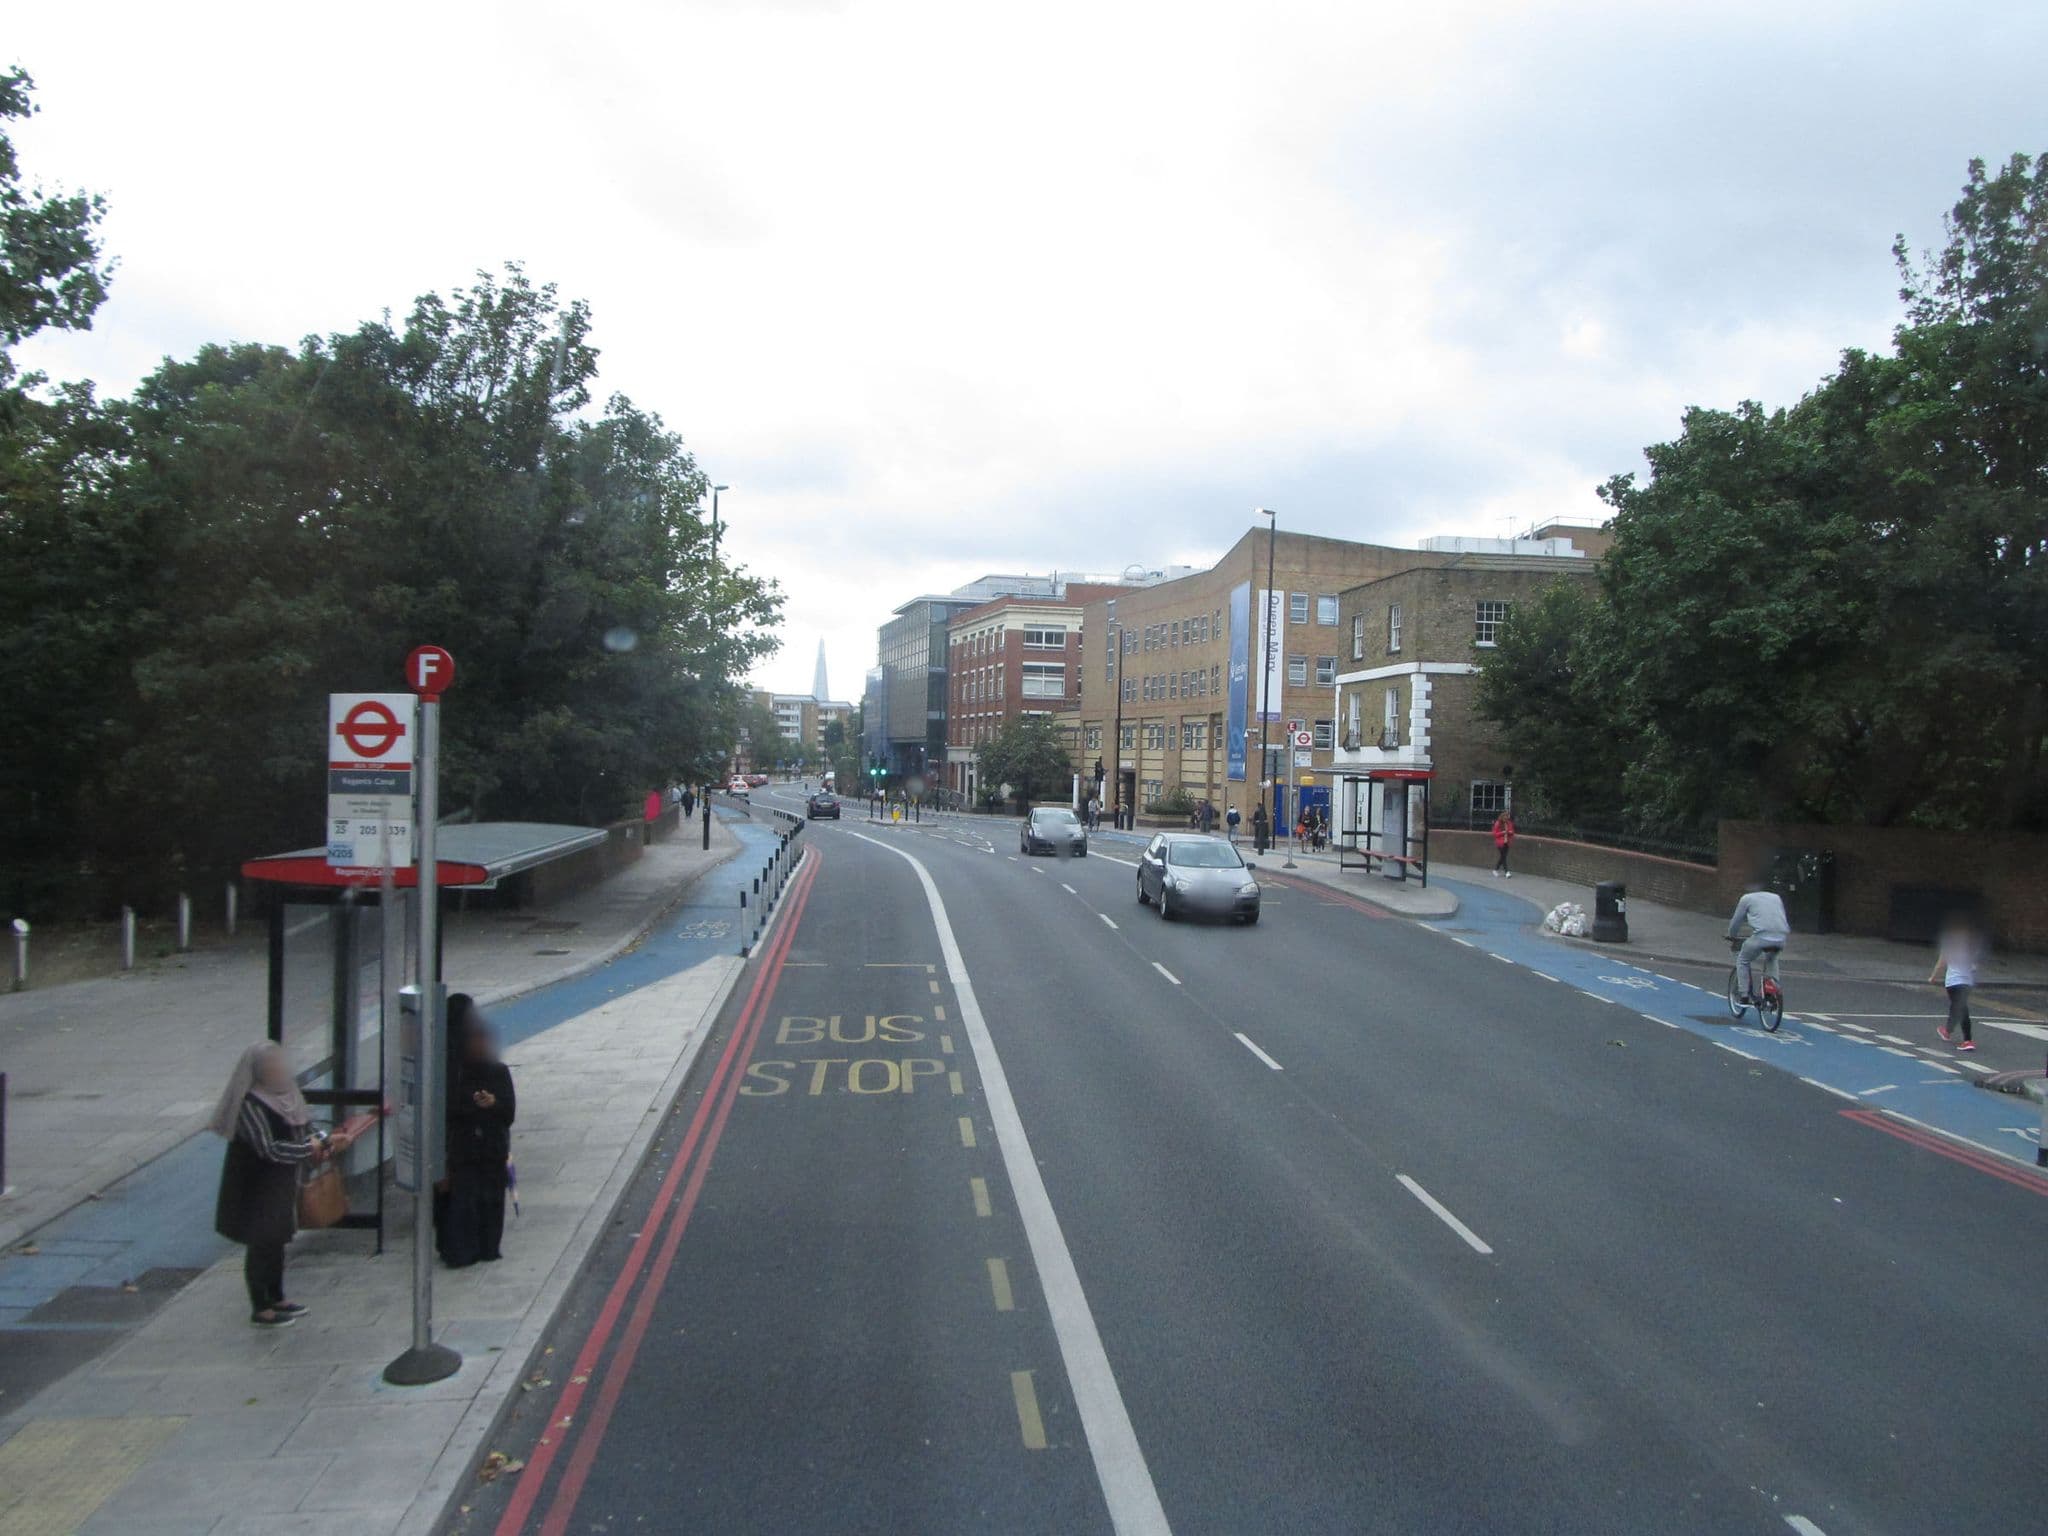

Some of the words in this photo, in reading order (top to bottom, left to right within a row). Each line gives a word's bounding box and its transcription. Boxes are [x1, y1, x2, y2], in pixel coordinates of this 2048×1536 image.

[1268, 595, 1280, 637] Queen
[418, 653, 441, 687] F
[1267, 641, 1279, 673] Mary
[1289, 722, 1297, 730] E
[335, 825, 346, 835] 25
[360, 825, 377, 835] 205
[388, 826, 406, 835] 339
[328, 849, 353, 858] N205
[775, 1015, 925, 1044] BUS
[739, 1058, 945, 1096] STOP
